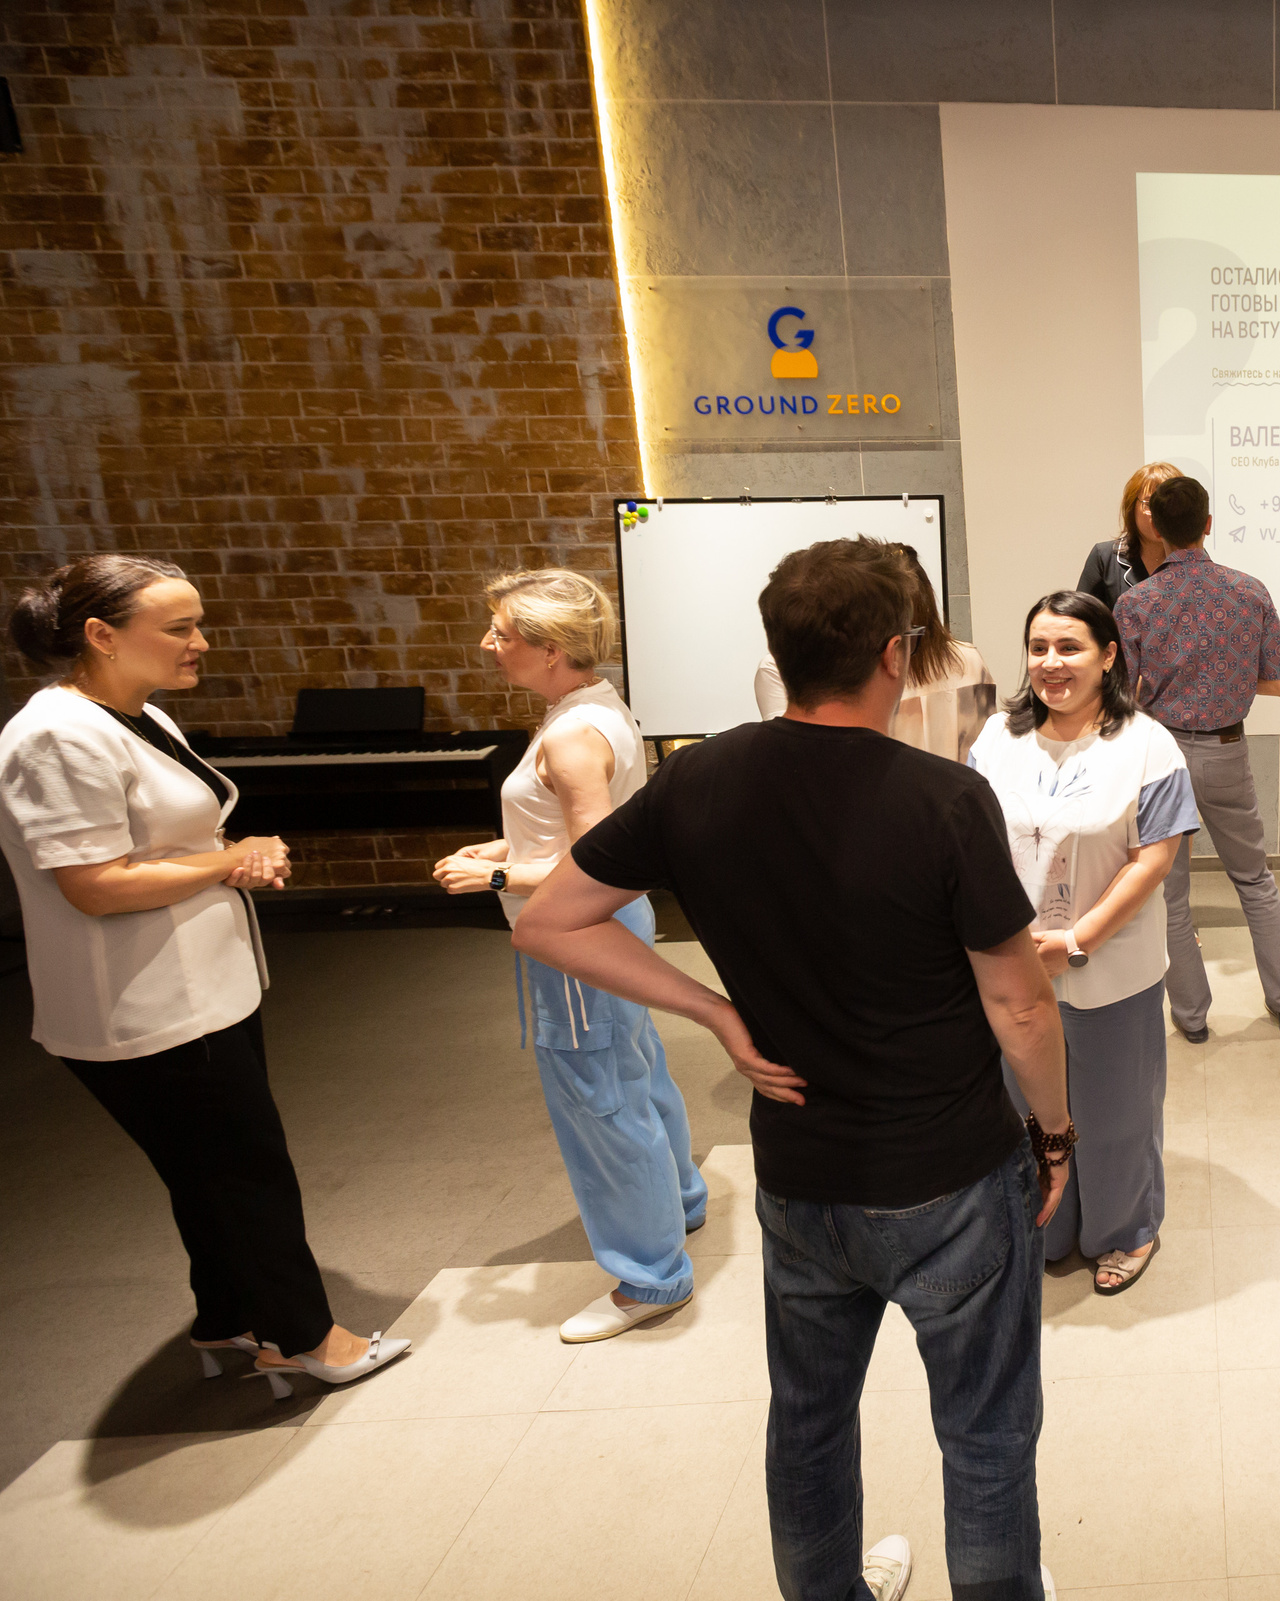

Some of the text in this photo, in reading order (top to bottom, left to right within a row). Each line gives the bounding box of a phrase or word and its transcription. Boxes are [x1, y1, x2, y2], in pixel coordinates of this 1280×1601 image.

[1211, 294, 1277, 313] ГОТОВЫ
[1211, 320, 1235, 339] НА
[1211, 367, 1263, 380] Свяжитесь
[1265, 370, 1271, 379] с
[694, 393, 902, 415] GROUND ZERO
[1252, 455, 1280, 469] Клуба
